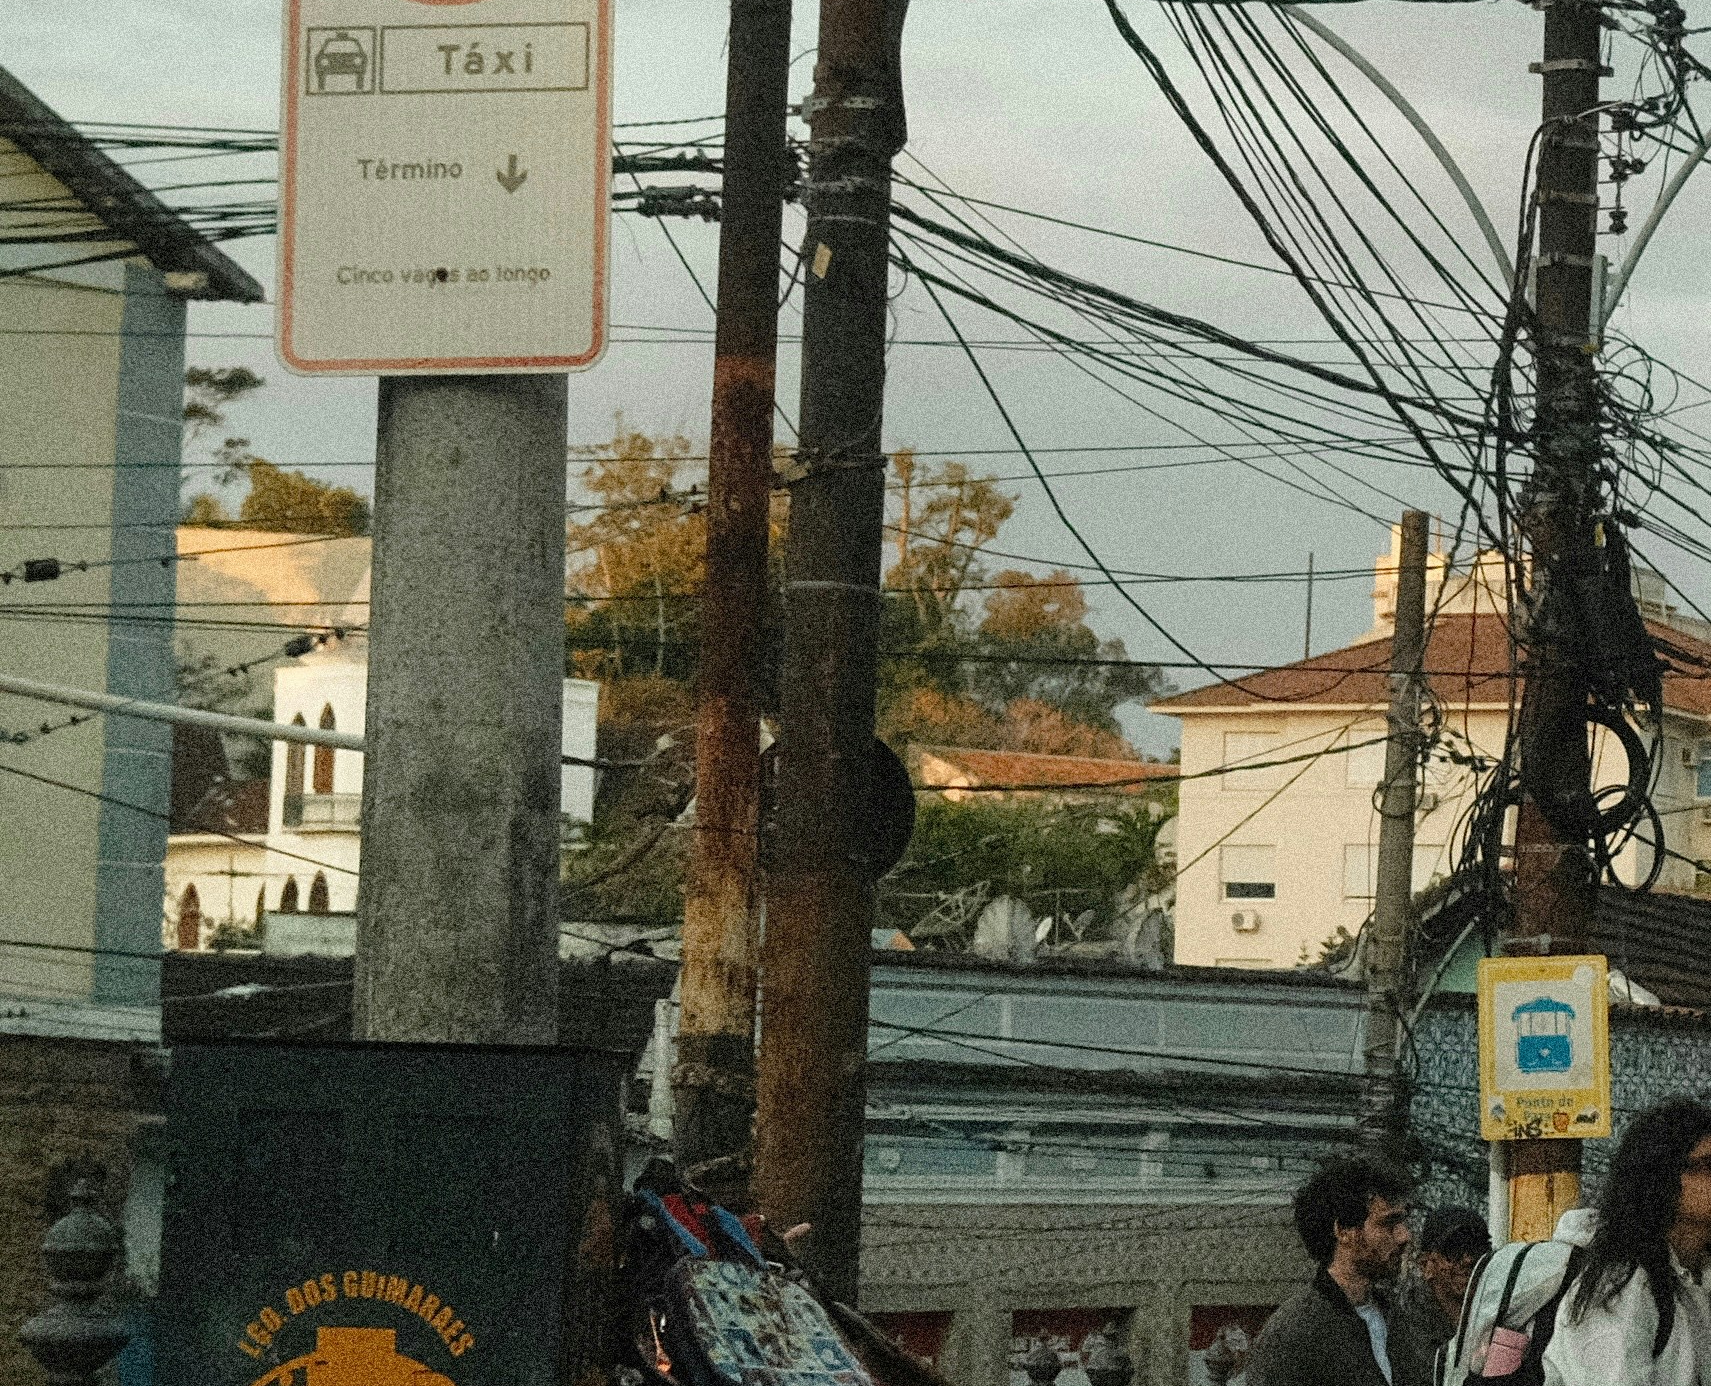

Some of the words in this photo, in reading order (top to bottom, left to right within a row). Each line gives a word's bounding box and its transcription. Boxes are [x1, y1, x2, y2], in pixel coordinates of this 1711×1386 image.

[437, 42, 533, 75] Táxi
[357, 158, 463, 181] Término
[337, 266, 394, 285] Cinco
[400, 267, 461, 289] vags
[466, 268, 489, 283] ao
[497, 266, 551, 286] longo
[285, 1273, 338, 1314] DOS
